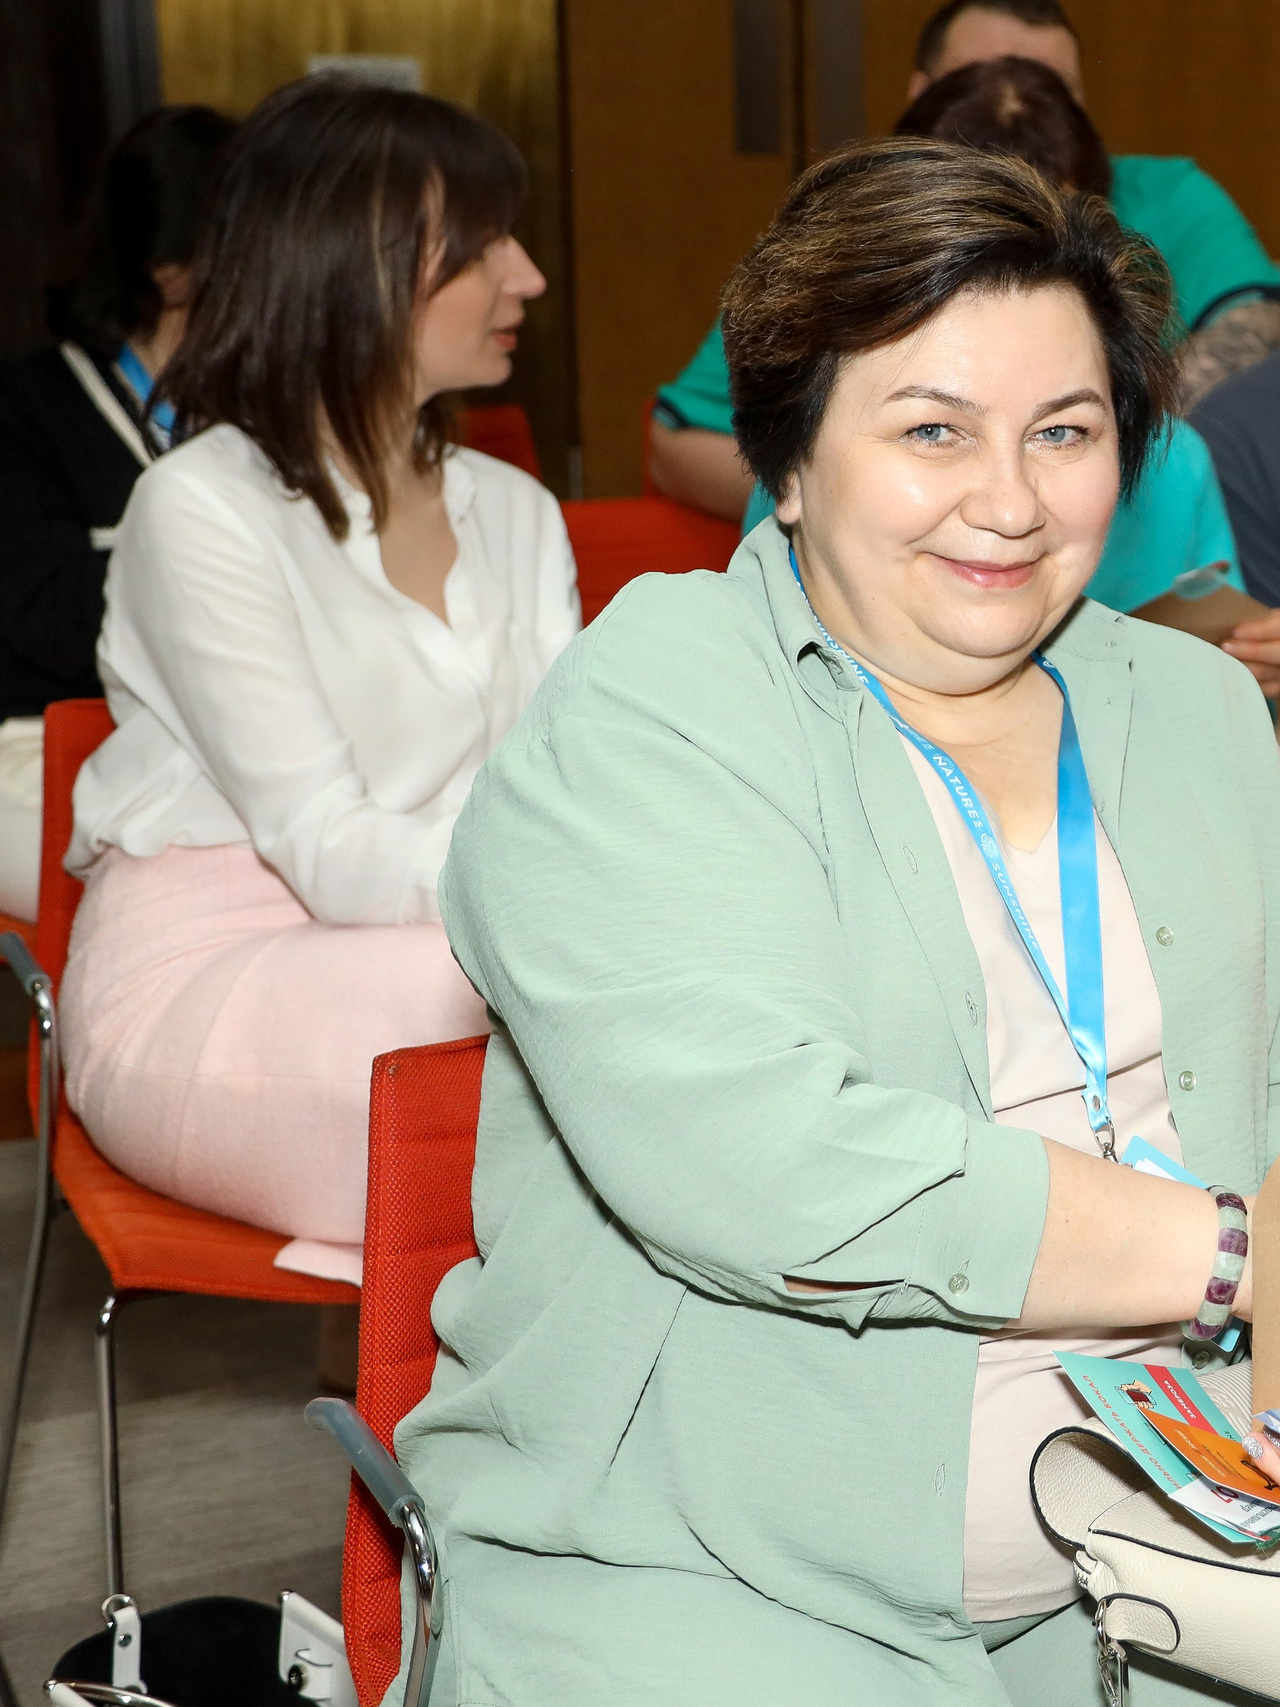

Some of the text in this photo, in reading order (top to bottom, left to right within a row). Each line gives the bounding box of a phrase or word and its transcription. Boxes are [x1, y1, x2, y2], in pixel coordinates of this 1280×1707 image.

[932, 753, 1040, 951] NATURES SUNSHINE
[1082, 1375, 1182, 1490] ИЛЬНО ДЕРЖАТЬ БОКАЛ
